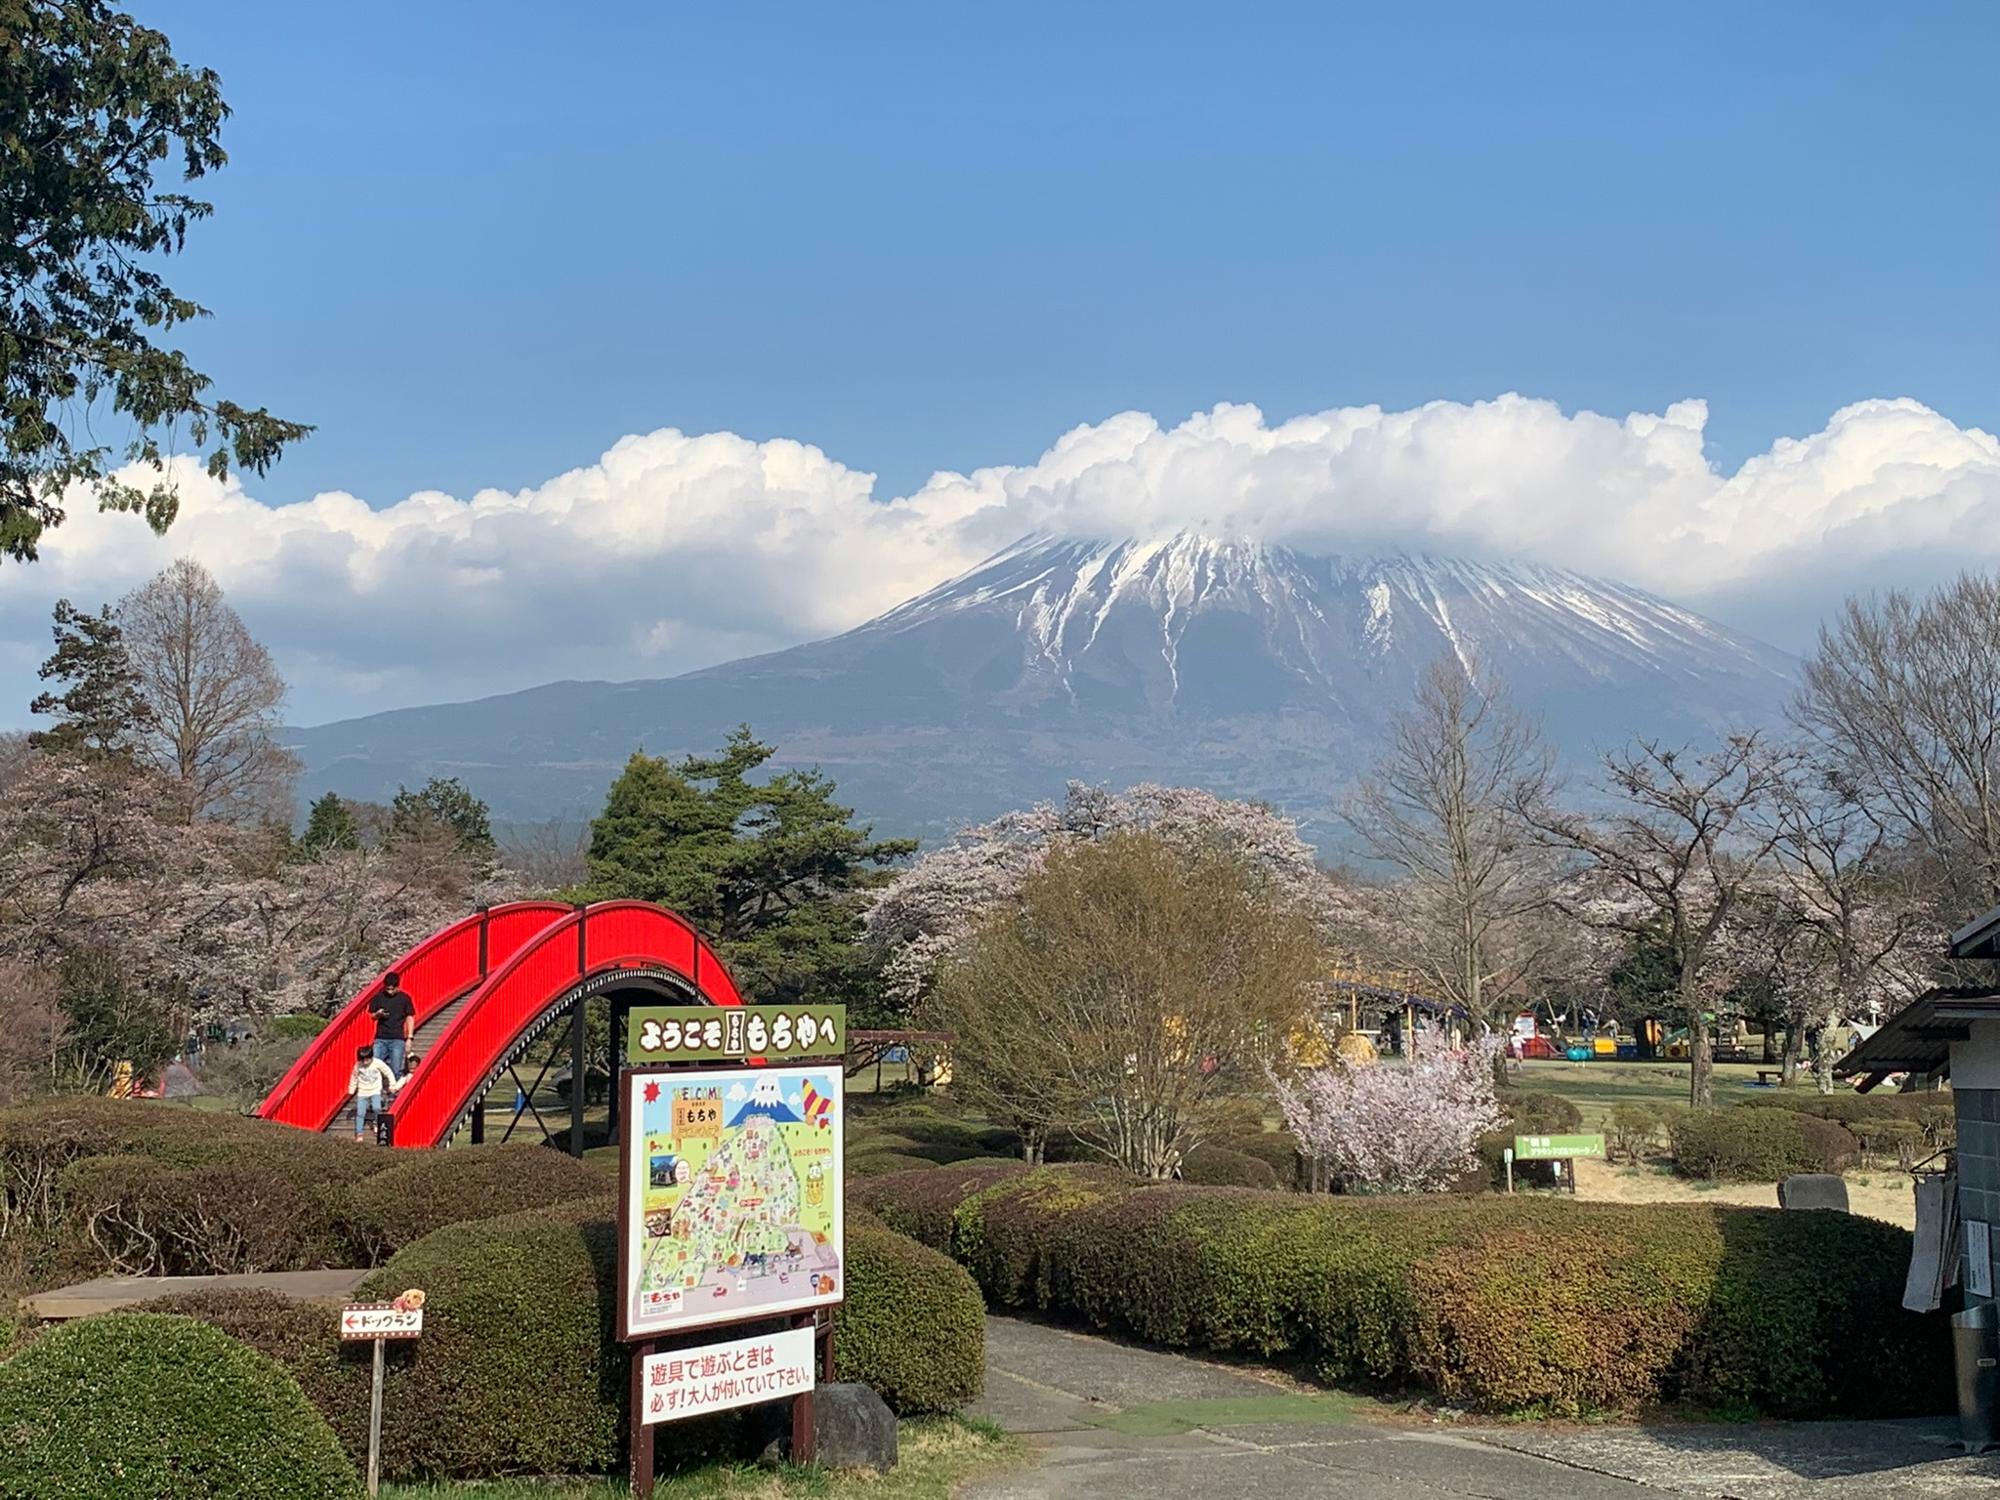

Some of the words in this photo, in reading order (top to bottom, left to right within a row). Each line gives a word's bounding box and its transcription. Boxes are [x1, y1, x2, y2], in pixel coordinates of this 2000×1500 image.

[640, 1019, 723, 1051] ようこそ
[747, 1013, 837, 1053] もちやへ
[673, 1087, 722, 1100] WELCOME
[687, 1108, 717, 1123] もちや
[361, 1313, 417, 1328] ドックラン
[651, 1344, 775, 1386] 遊具で遊ぶときは
